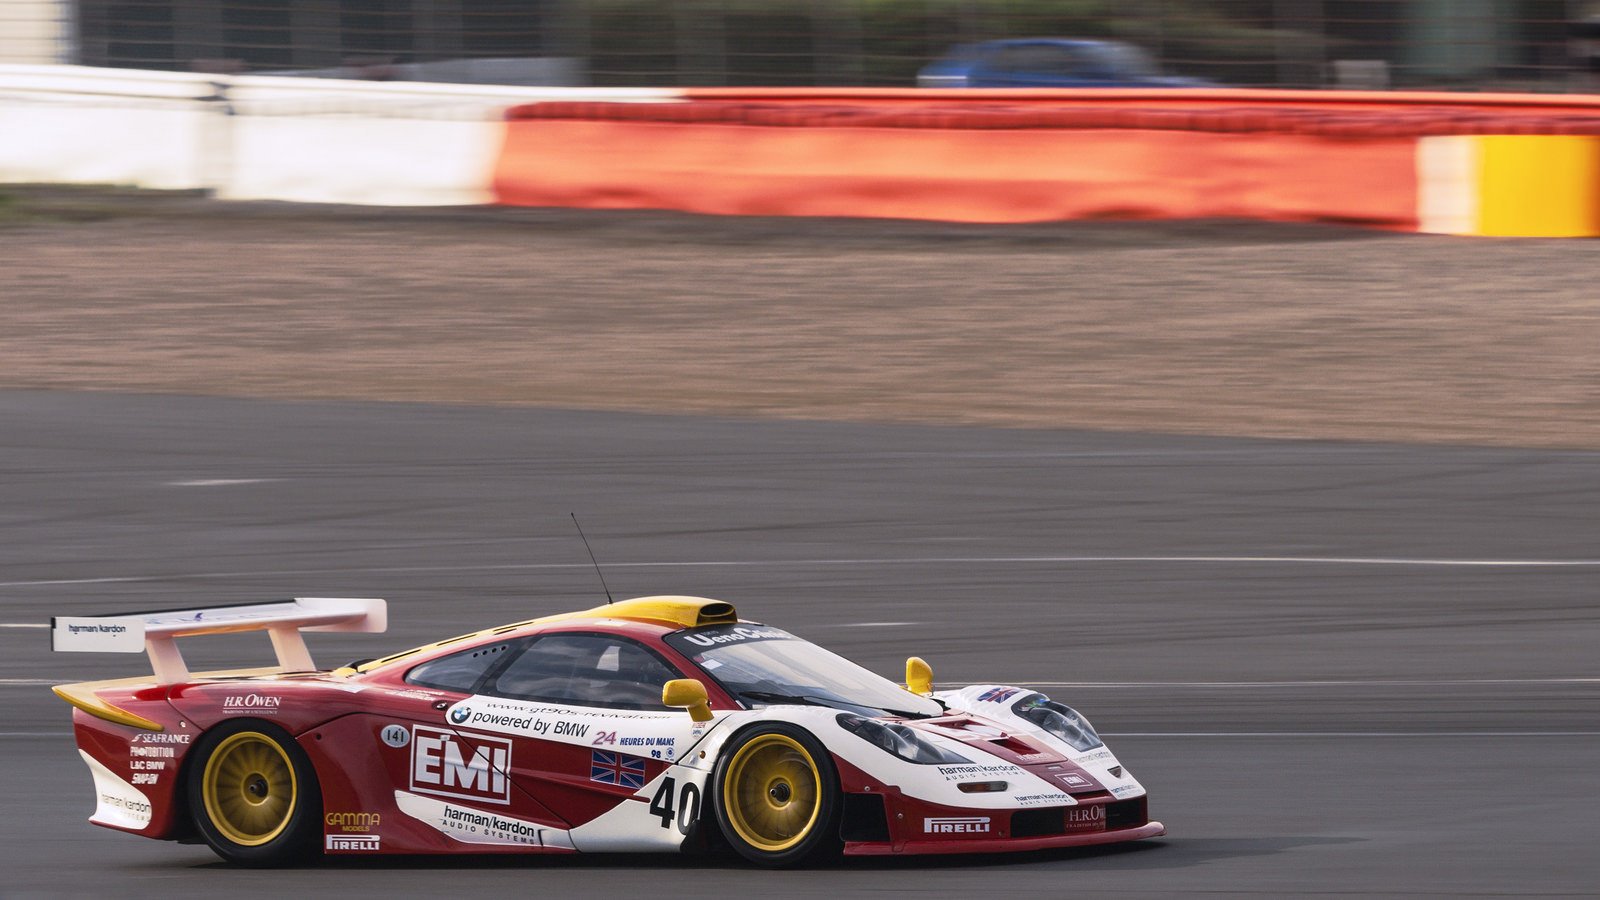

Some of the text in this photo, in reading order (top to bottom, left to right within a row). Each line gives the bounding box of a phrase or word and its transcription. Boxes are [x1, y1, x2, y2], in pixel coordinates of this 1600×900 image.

[471, 711, 590, 738] powered by BMW
[142, 733, 190, 744] SEAFRANCE
[387, 729, 404, 743] 141
[592, 730, 675, 746] 24 HEURES DU MANS
[651, 749, 662, 759] 98
[146, 760, 166, 770] BMW
[415, 735, 506, 794] EMI
[649, 776, 700, 836] 40
[325, 812, 381, 826] GAMMA
[443, 805, 535, 837] harman/kardon
[923, 816, 991, 833] PIRELLI
[442, 820, 535, 845] AUDIO SYSTEMS
[326, 834, 381, 850] PIRELLI
